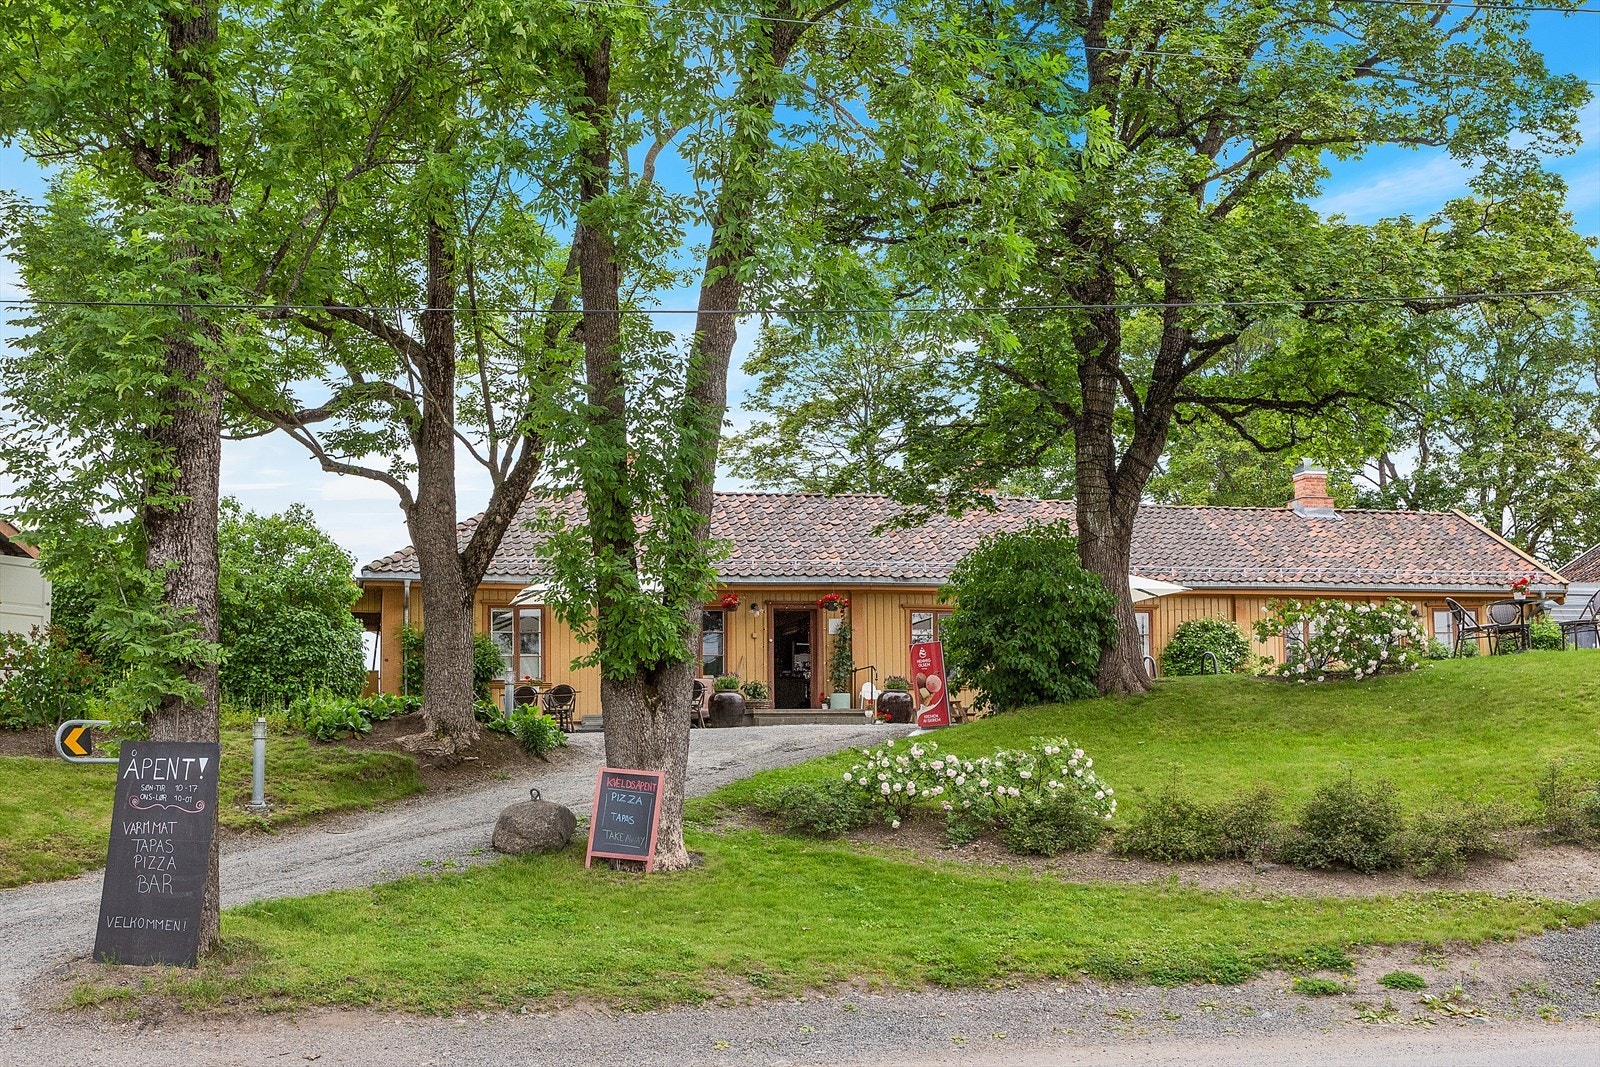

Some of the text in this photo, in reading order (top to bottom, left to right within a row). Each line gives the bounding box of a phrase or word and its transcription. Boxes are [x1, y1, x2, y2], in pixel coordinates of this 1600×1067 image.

[123, 749, 209, 781] ÅPENT!
[611, 792, 643, 805] PIZZA
[610, 811, 635, 825] TAPAS
[131, 838, 175, 854] TAPAS
[133, 854, 177, 872] PIZZA
[136, 873, 174, 895] BAR
[106, 915, 188, 932] VELKOMMEN!
